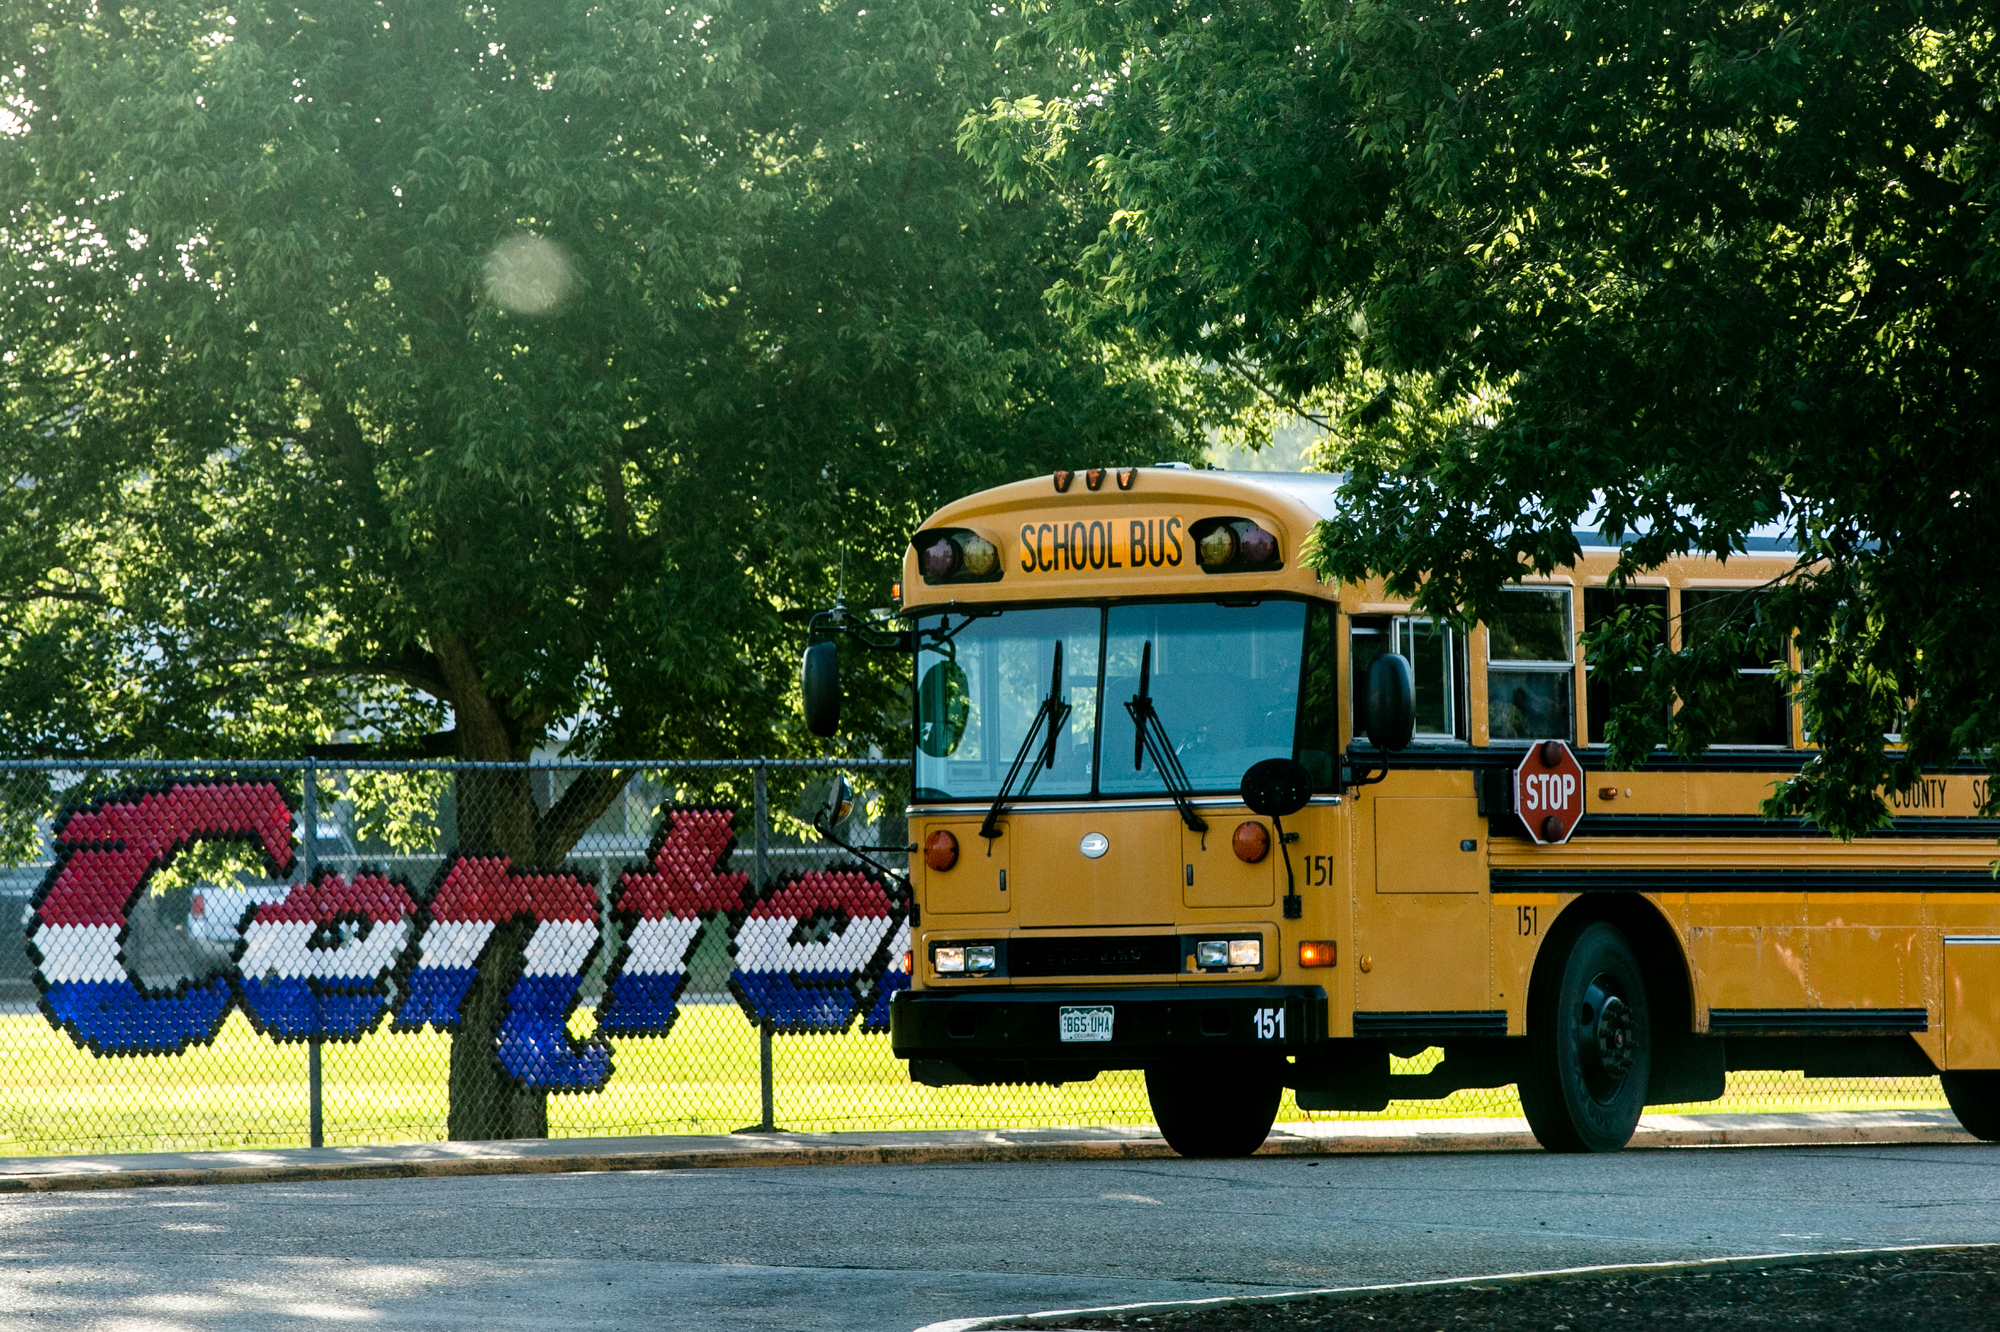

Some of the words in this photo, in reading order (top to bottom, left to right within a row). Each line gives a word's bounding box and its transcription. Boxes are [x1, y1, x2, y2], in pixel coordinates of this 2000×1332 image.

[1021, 520, 1122, 573] SCHOOL
[1130, 517, 1182, 567] BUS
[1526, 773, 1576, 811] STOP
[1304, 855, 1333, 886] 151
[1517, 906, 1537, 936] 151
[1253, 1007, 1285, 1039] 151
